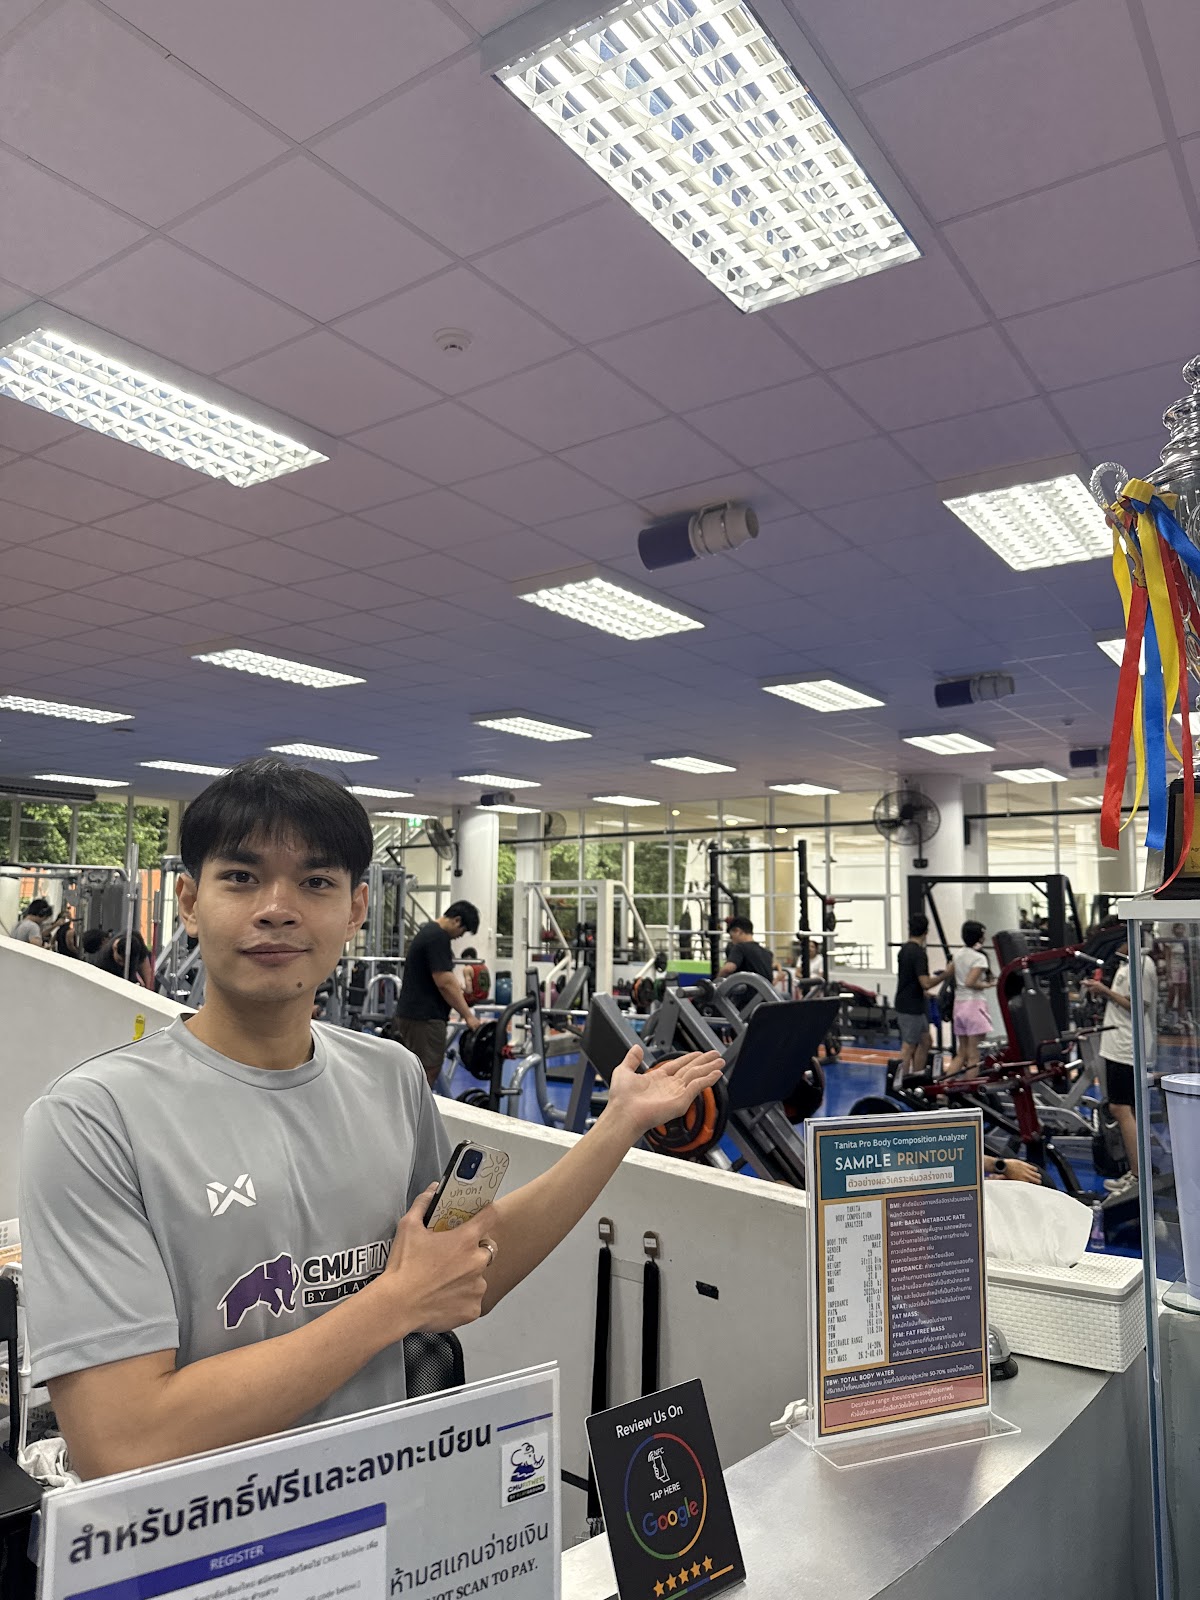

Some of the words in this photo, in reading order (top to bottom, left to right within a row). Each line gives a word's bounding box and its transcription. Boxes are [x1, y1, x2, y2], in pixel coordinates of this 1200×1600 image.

[834, 1141, 858, 1149] Tanita
[859, 1140, 871, 1148] Pro
[873, 1138, 891, 1148] Body
[892, 1136, 937, 1146] Composition
[938, 1134, 967, 1142] Analyzer
[835, 1154, 892, 1170] SAMPLE
[898, 1148, 964, 1166] PRINTOUT
[848, 1170, 952, 1188] ตัวอย่างผลวิเคราะห์มวลร่างกาย
[303, 1242, 393, 1283] CMUFITN
[891, 1265, 923, 1273] IMPEDANCE:
[308, 1290, 326, 1302] BY
[828, 1299, 848, 1308] IMPEDANCE
[931, 1325, 945, 1333] MASS
[840, 1376, 858, 1384] TOTAL
[876, 1370, 894, 1378] WATER
[851, 1400, 875, 1408] Desirable
[616, 1417, 652, 1438] Review
[654, 1410, 666, 1424] Us
[668, 1405, 683, 1418] On
[653, 1447, 664, 1456] NFC
[70, 1424, 492, 1564] สำหรับสิทธิ์ฟรีและลงทะเบียน
[650, 1490, 662, 1501] TAP
[664, 1482, 681, 1496] HERE
[643, 1496, 699, 1536] Google
[210, 1545, 264, 1571] REGISTER
[391, 1522, 548, 1596] ห้ามสแกนจ่ายเงิน
[427, 1590, 454, 1600] OT
[456, 1576, 488, 1599] SCAN
[492, 1569, 508, 1585] TO
[511, 1558, 538, 1578] PAY.
